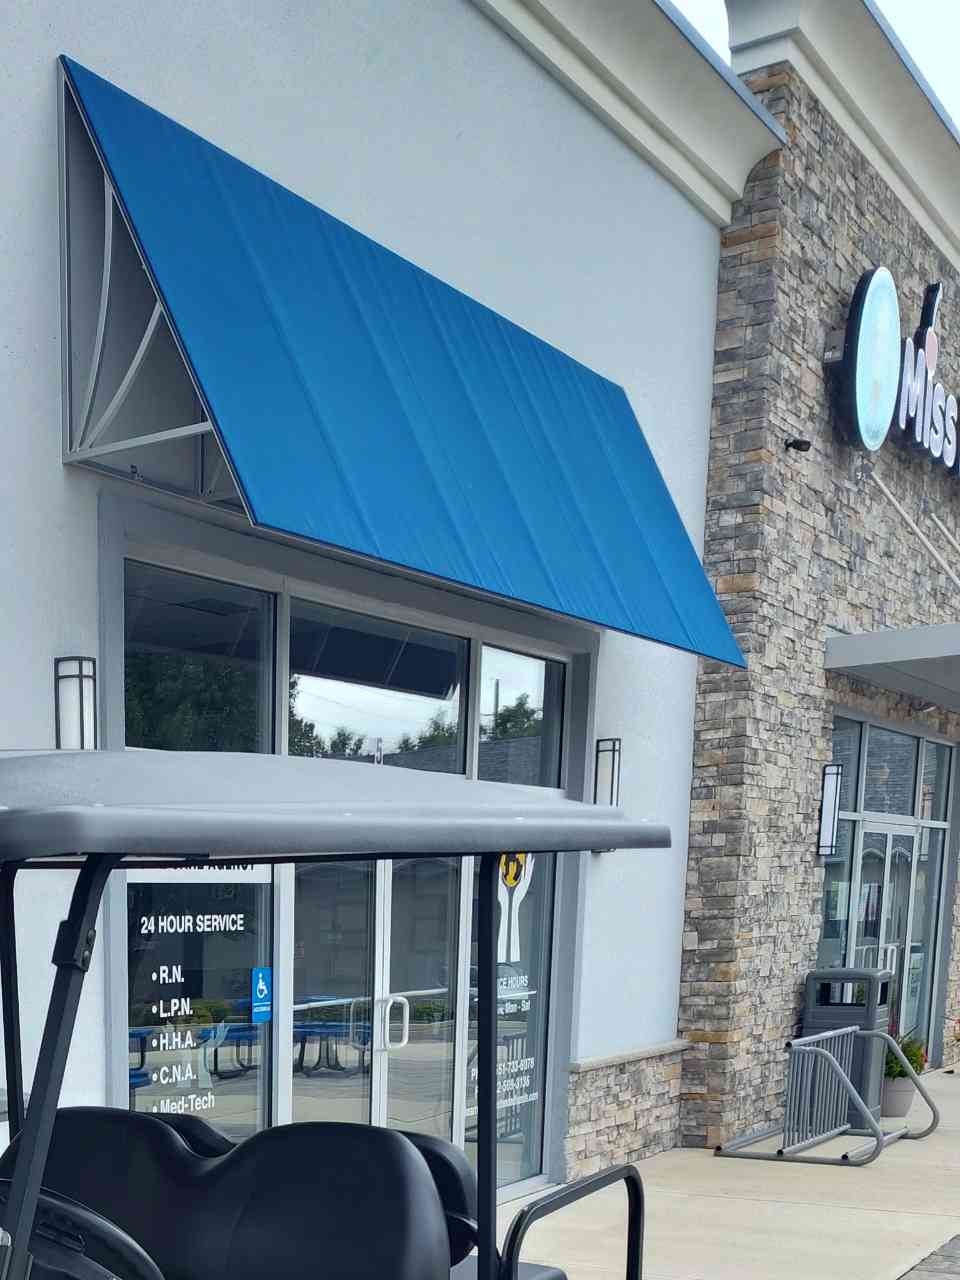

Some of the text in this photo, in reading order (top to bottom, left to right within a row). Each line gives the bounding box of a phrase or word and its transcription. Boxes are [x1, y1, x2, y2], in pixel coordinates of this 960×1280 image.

[140, 914, 245, 934] 24 HOUR SERVICE
[159, 964, 185, 985] R.N.
[159, 997, 194, 1018] L.P.N.
[159, 1030, 197, 1052] H.H.A.
[159, 1063, 197, 1085] C.N.A.
[160, 1091, 215, 1114] Med-Tech
